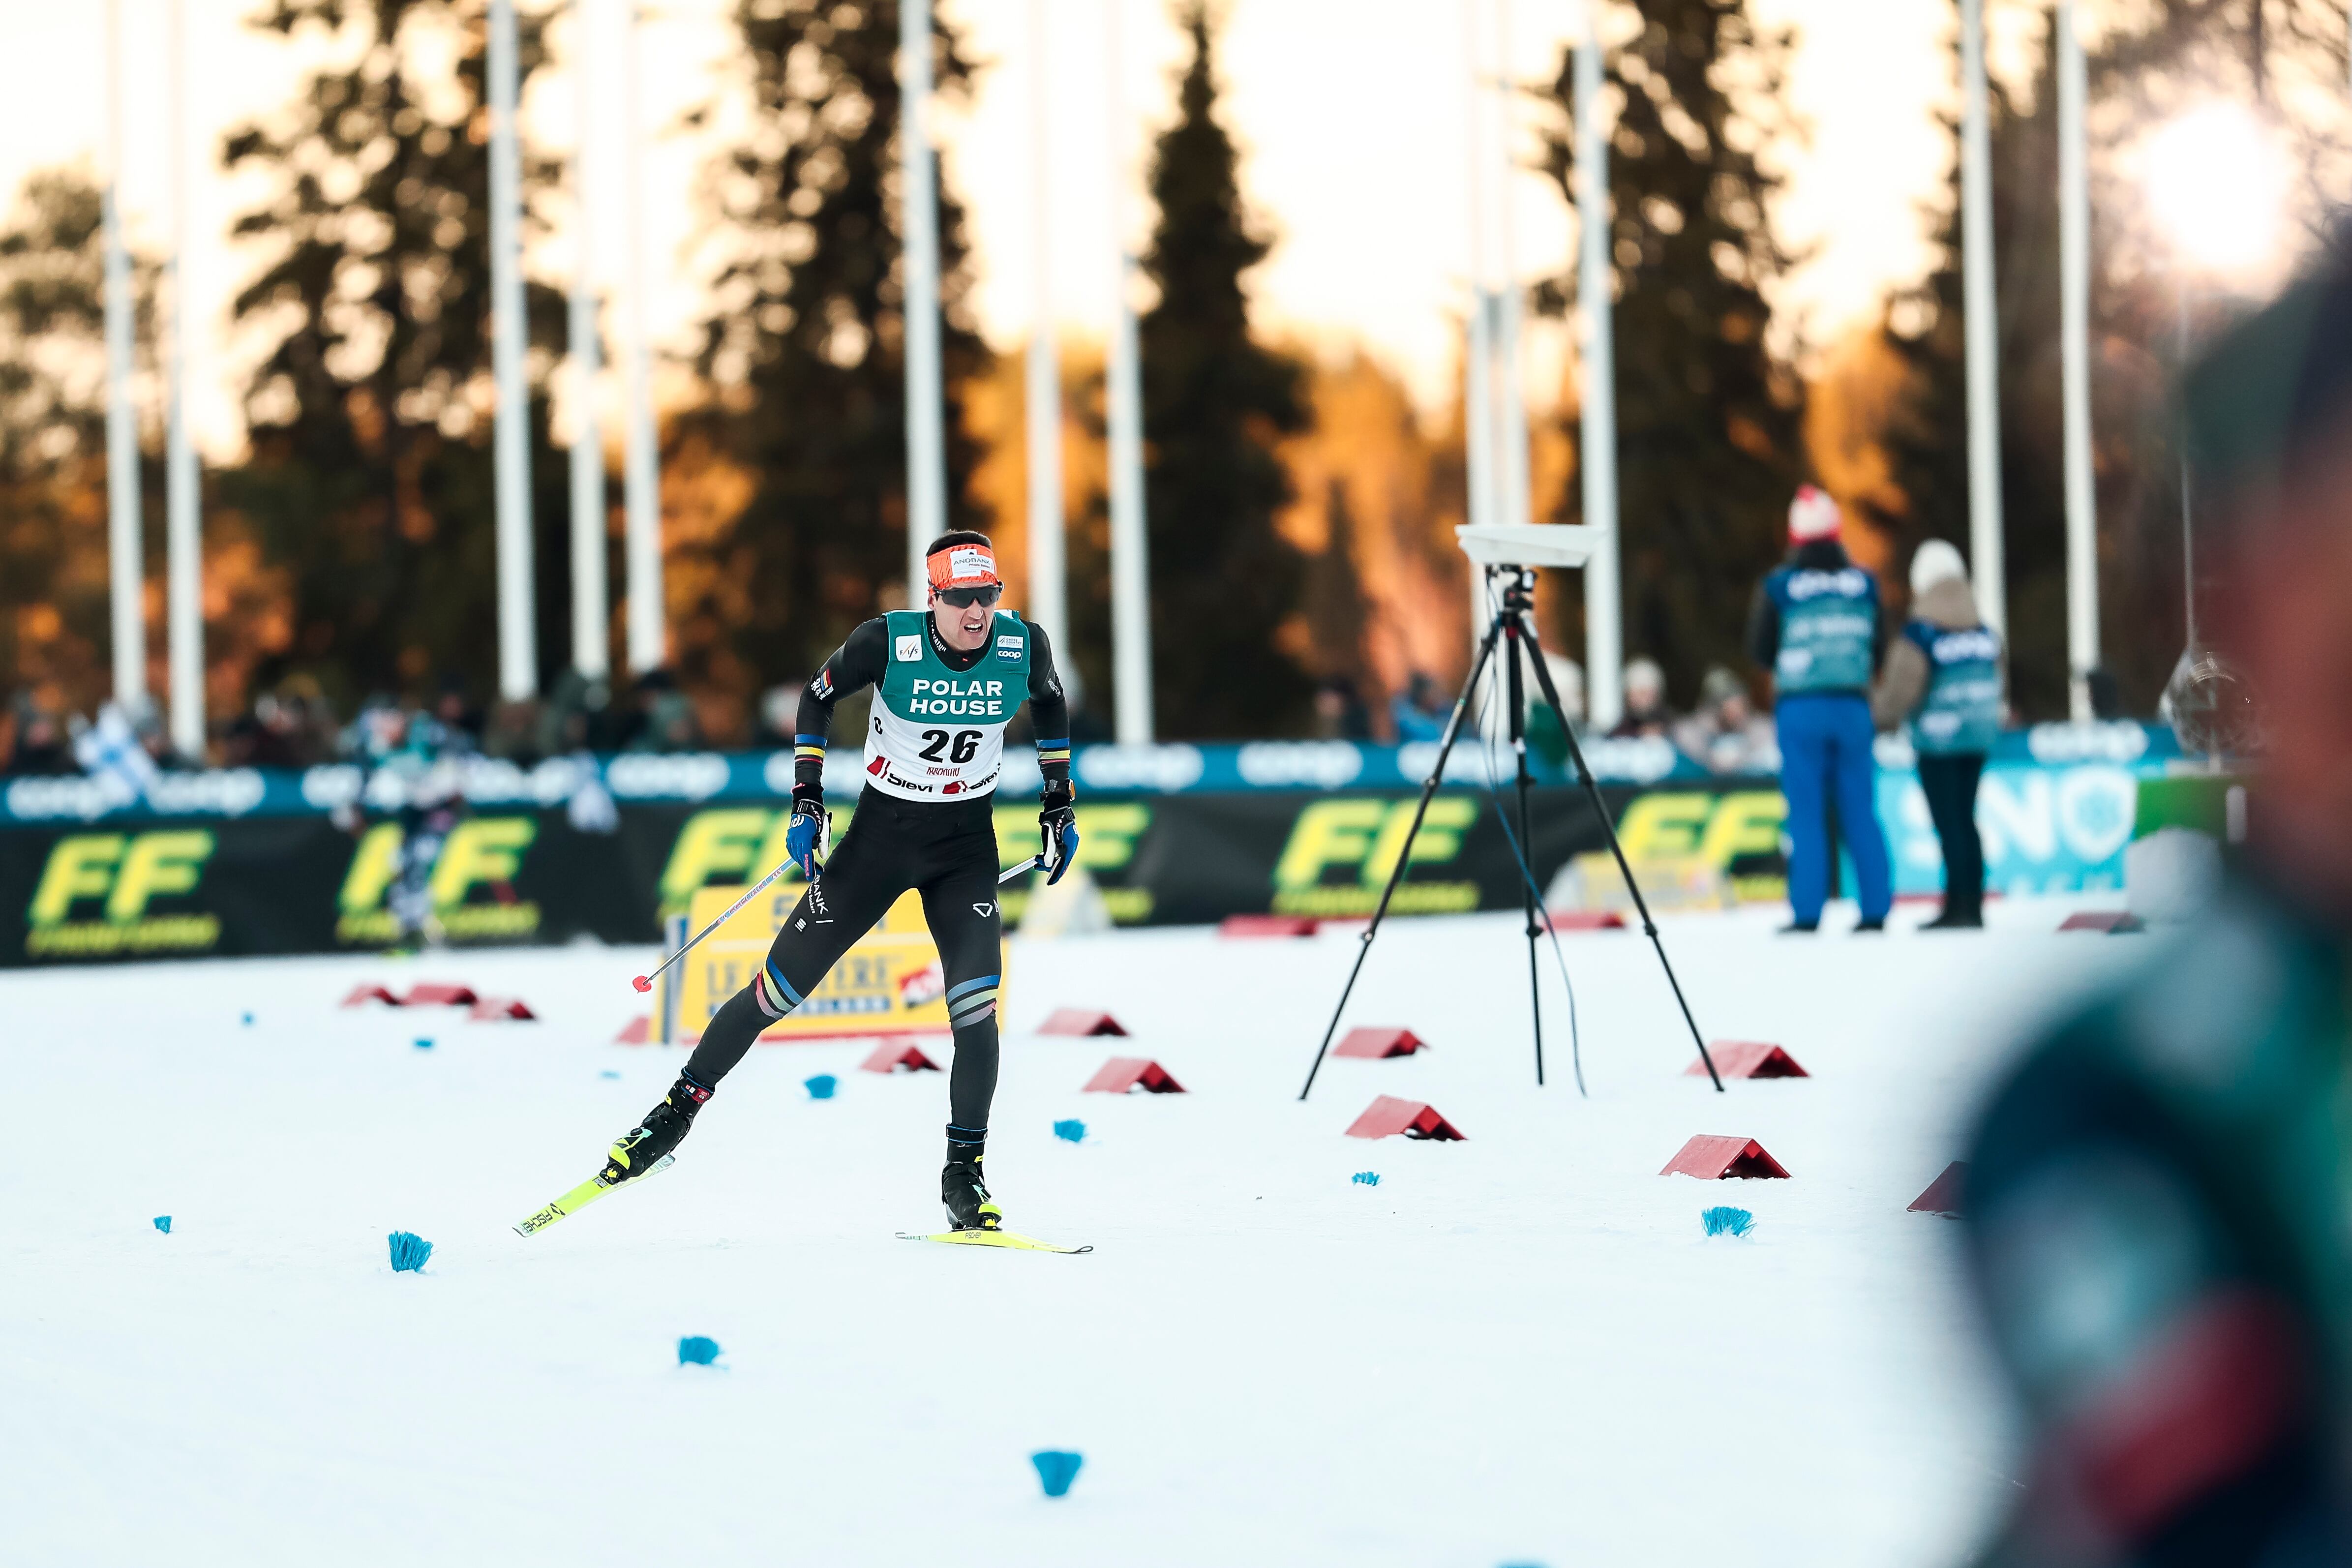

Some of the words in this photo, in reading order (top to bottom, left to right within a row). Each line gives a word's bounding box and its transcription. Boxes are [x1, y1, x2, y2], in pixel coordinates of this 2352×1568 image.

[998, 650, 1022, 659] coop
[912, 679, 1003, 696] POLAR
[909, 698, 1002, 716] HOUSE
[918, 729, 983, 763] 26
[1273, 797, 1478, 888] FF
[28, 830, 213, 926] FF
[521, 1210, 553, 1234] FISCHER
